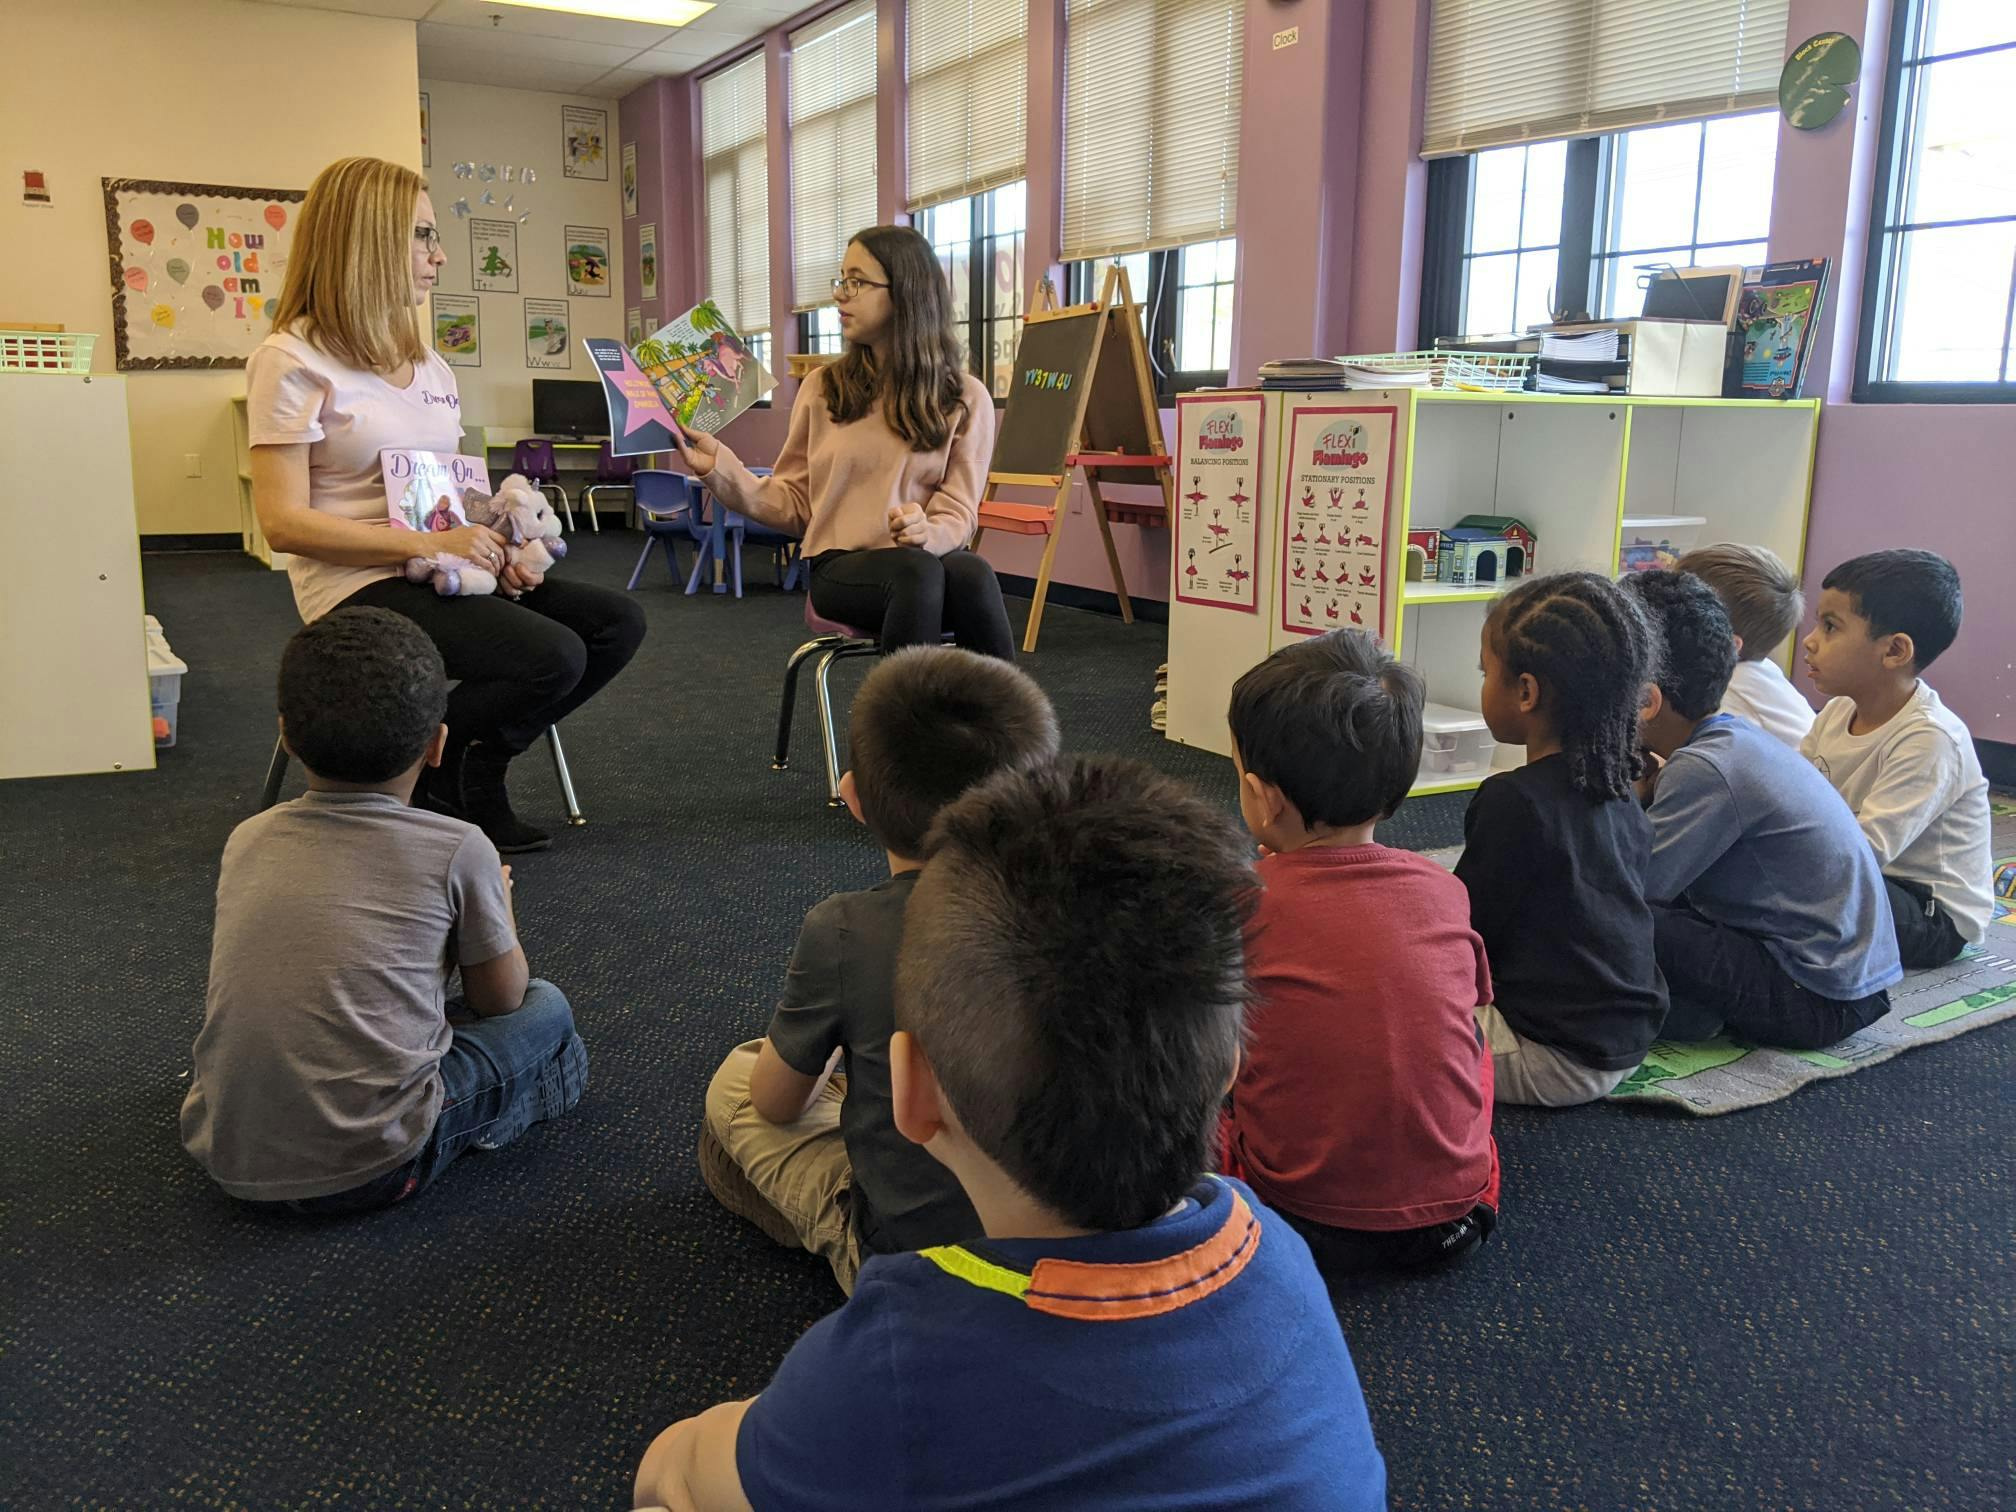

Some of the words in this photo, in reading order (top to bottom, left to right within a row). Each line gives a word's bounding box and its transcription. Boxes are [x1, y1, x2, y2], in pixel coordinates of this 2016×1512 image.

[1274, 30, 1297, 48] Clock
[1795, 45, 1812, 60] Block
[206, 226, 264, 250] How
[216, 251, 259, 273] old
[222, 277, 261, 293] am
[233, 295, 264, 320] I?
[1199, 434, 1244, 452] Flamingo
[390, 454, 448, 479] Dream
[1222, 458, 1249, 466] POSITIONS
[1312, 449, 1368, 468] Flamingo
[1301, 474, 1339, 484] STATIONARY
[1340, 476, 1376, 485] POSITIONS
